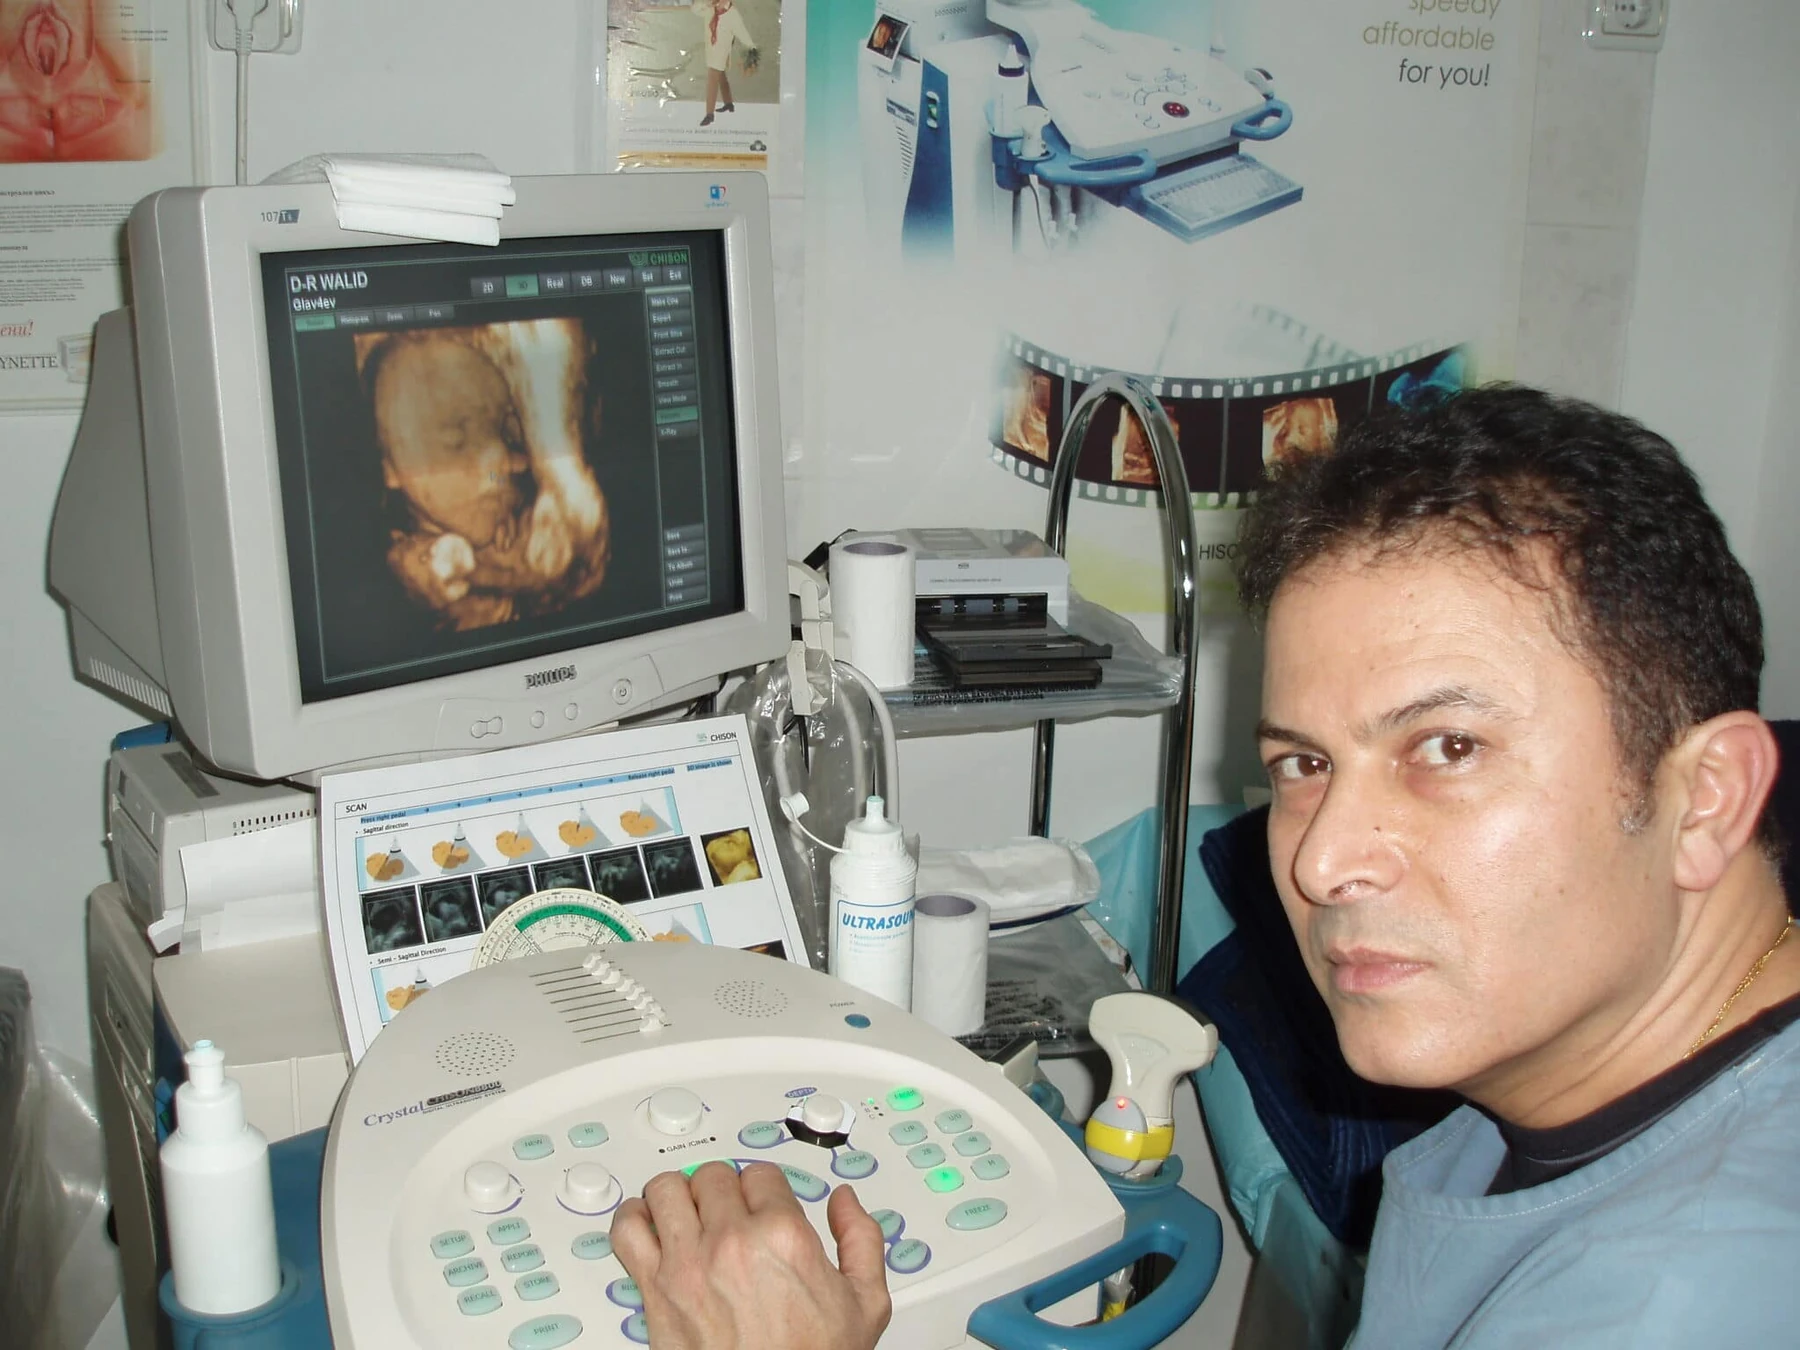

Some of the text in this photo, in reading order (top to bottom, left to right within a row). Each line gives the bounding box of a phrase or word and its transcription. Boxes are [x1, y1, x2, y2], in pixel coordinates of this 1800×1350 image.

[1408, 0, 1500, 20] speedy
[1362, 21, 1495, 51] affordable
[1399, 58, 1490, 90] for you!
[290, 271, 369, 293] D-R WALID
[0, 355, 58, 370] YNETTE
[525, 665, 578, 689] PHILIPS
[710, 732, 737, 741] CHISON
[346, 803, 368, 813] SCAN
[363, 822, 409, 835] Sagittal direction
[420, 947, 447, 956] Direction
[363, 1101, 425, 1127] Crystal
[964, 1204, 992, 1216] FREEZE
[438, 1234, 467, 1247] SETUP
[581, 1236, 607, 1248] CLEAR
[506, 1247, 540, 1262] REPORT
[448, 1260, 484, 1277] ARCHIVE
[523, 1275, 551, 1289] STORE
[463, 1289, 498, 1305] RECALL
[533, 1322, 560, 1336] PRINT
